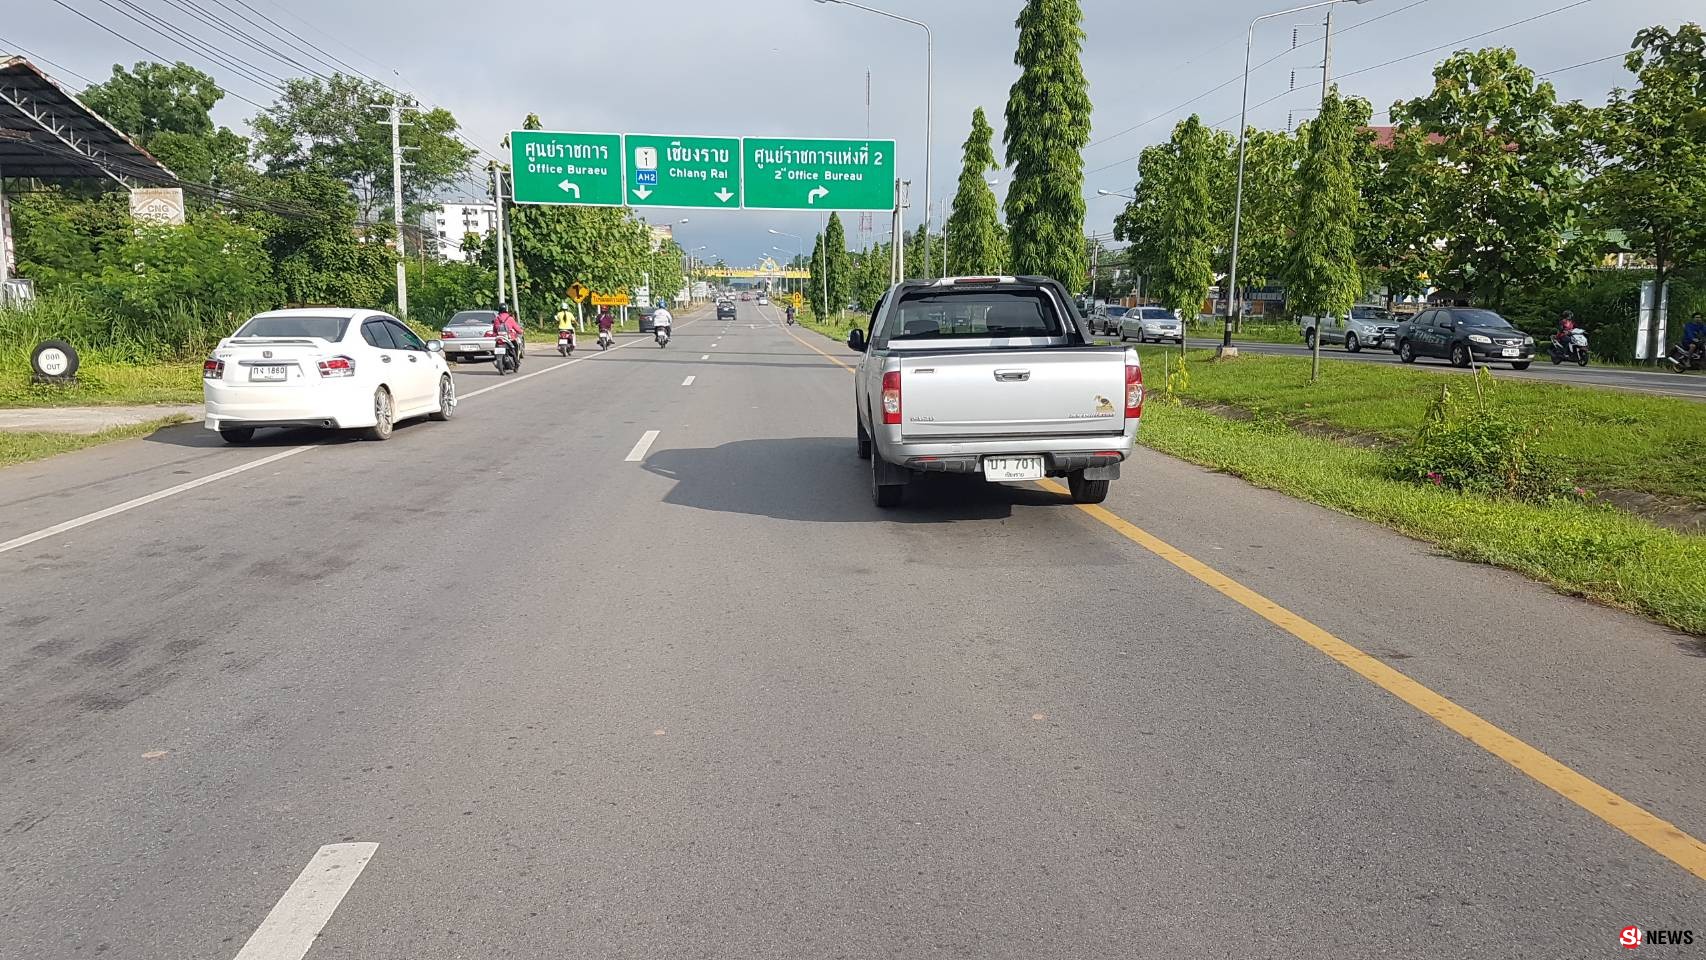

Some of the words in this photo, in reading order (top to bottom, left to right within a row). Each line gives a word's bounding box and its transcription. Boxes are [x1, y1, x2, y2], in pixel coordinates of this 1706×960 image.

[525, 140, 608, 162] ศูนย์ราชการ
[665, 141, 729, 162] เชียงราย
[754, 142, 869, 169] ศูนย์ราชการแห่งที่
[873, 151, 884, 166] 2
[528, 163, 563, 174] Office
[567, 164, 608, 176] Buraeu
[669, 167, 707, 181] Chiang
[710, 168, 729, 179] Rai
[787, 170, 819, 180] Office
[824, 170, 863, 181] Bureau
[638, 173, 656, 182] AH2
[147, 204, 170, 213] CNG
[46, 363, 61, 371] OUT
[1015, 459, 1035, 470] 701
